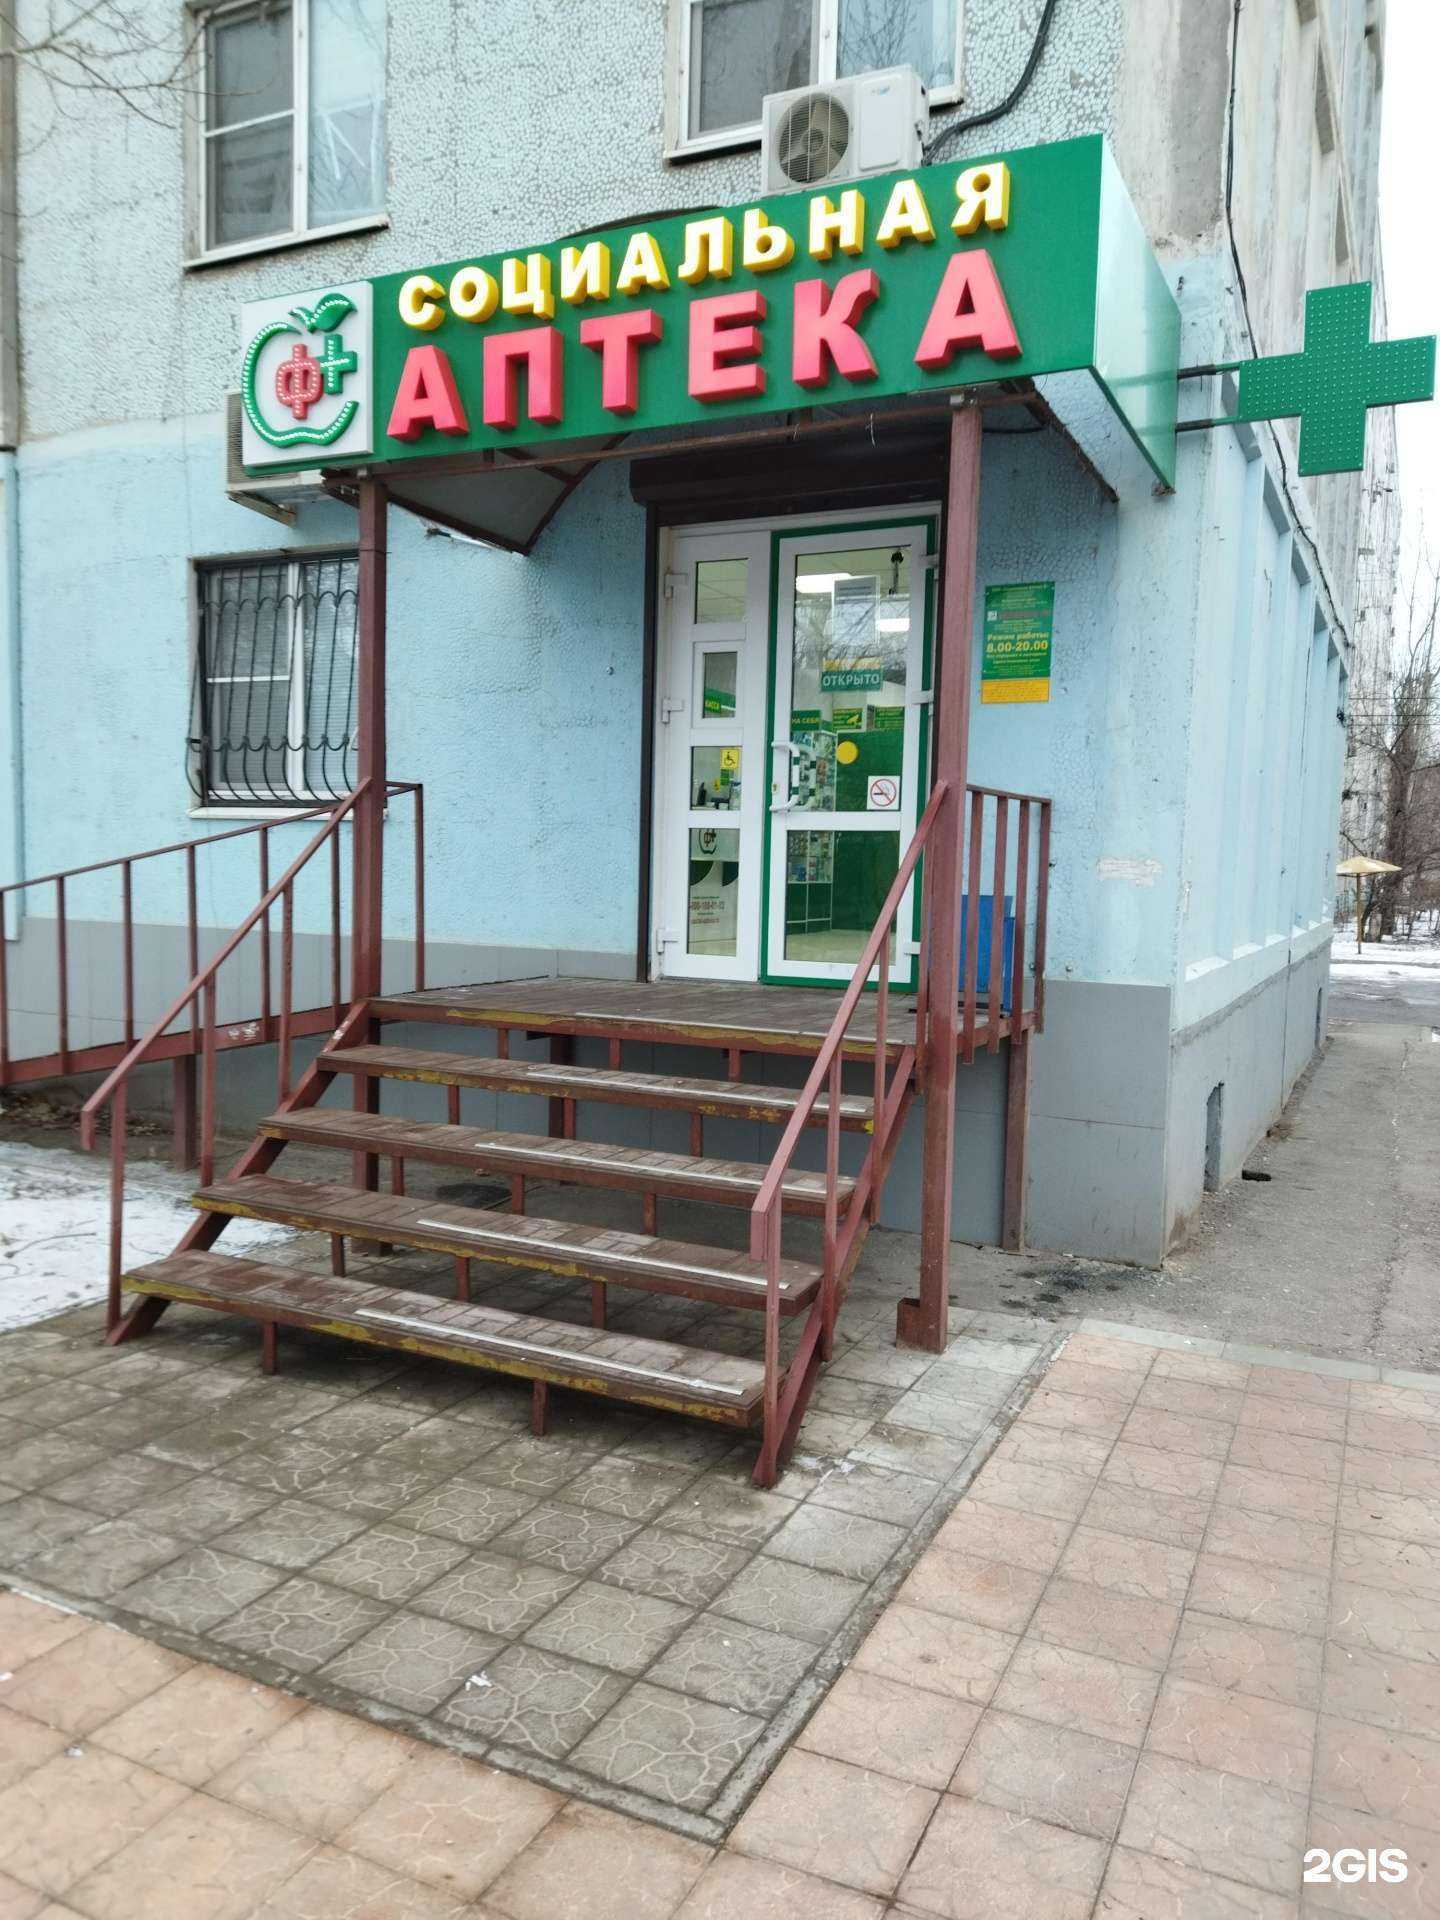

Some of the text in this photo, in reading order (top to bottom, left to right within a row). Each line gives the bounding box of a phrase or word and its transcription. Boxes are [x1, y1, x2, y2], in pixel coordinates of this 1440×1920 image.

[399, 161, 1011, 331] СОЦИАЛЬНАЯ
[387, 248, 1023, 442] АПТЕКА
[822, 673, 880, 687] ОТКРЫТО
